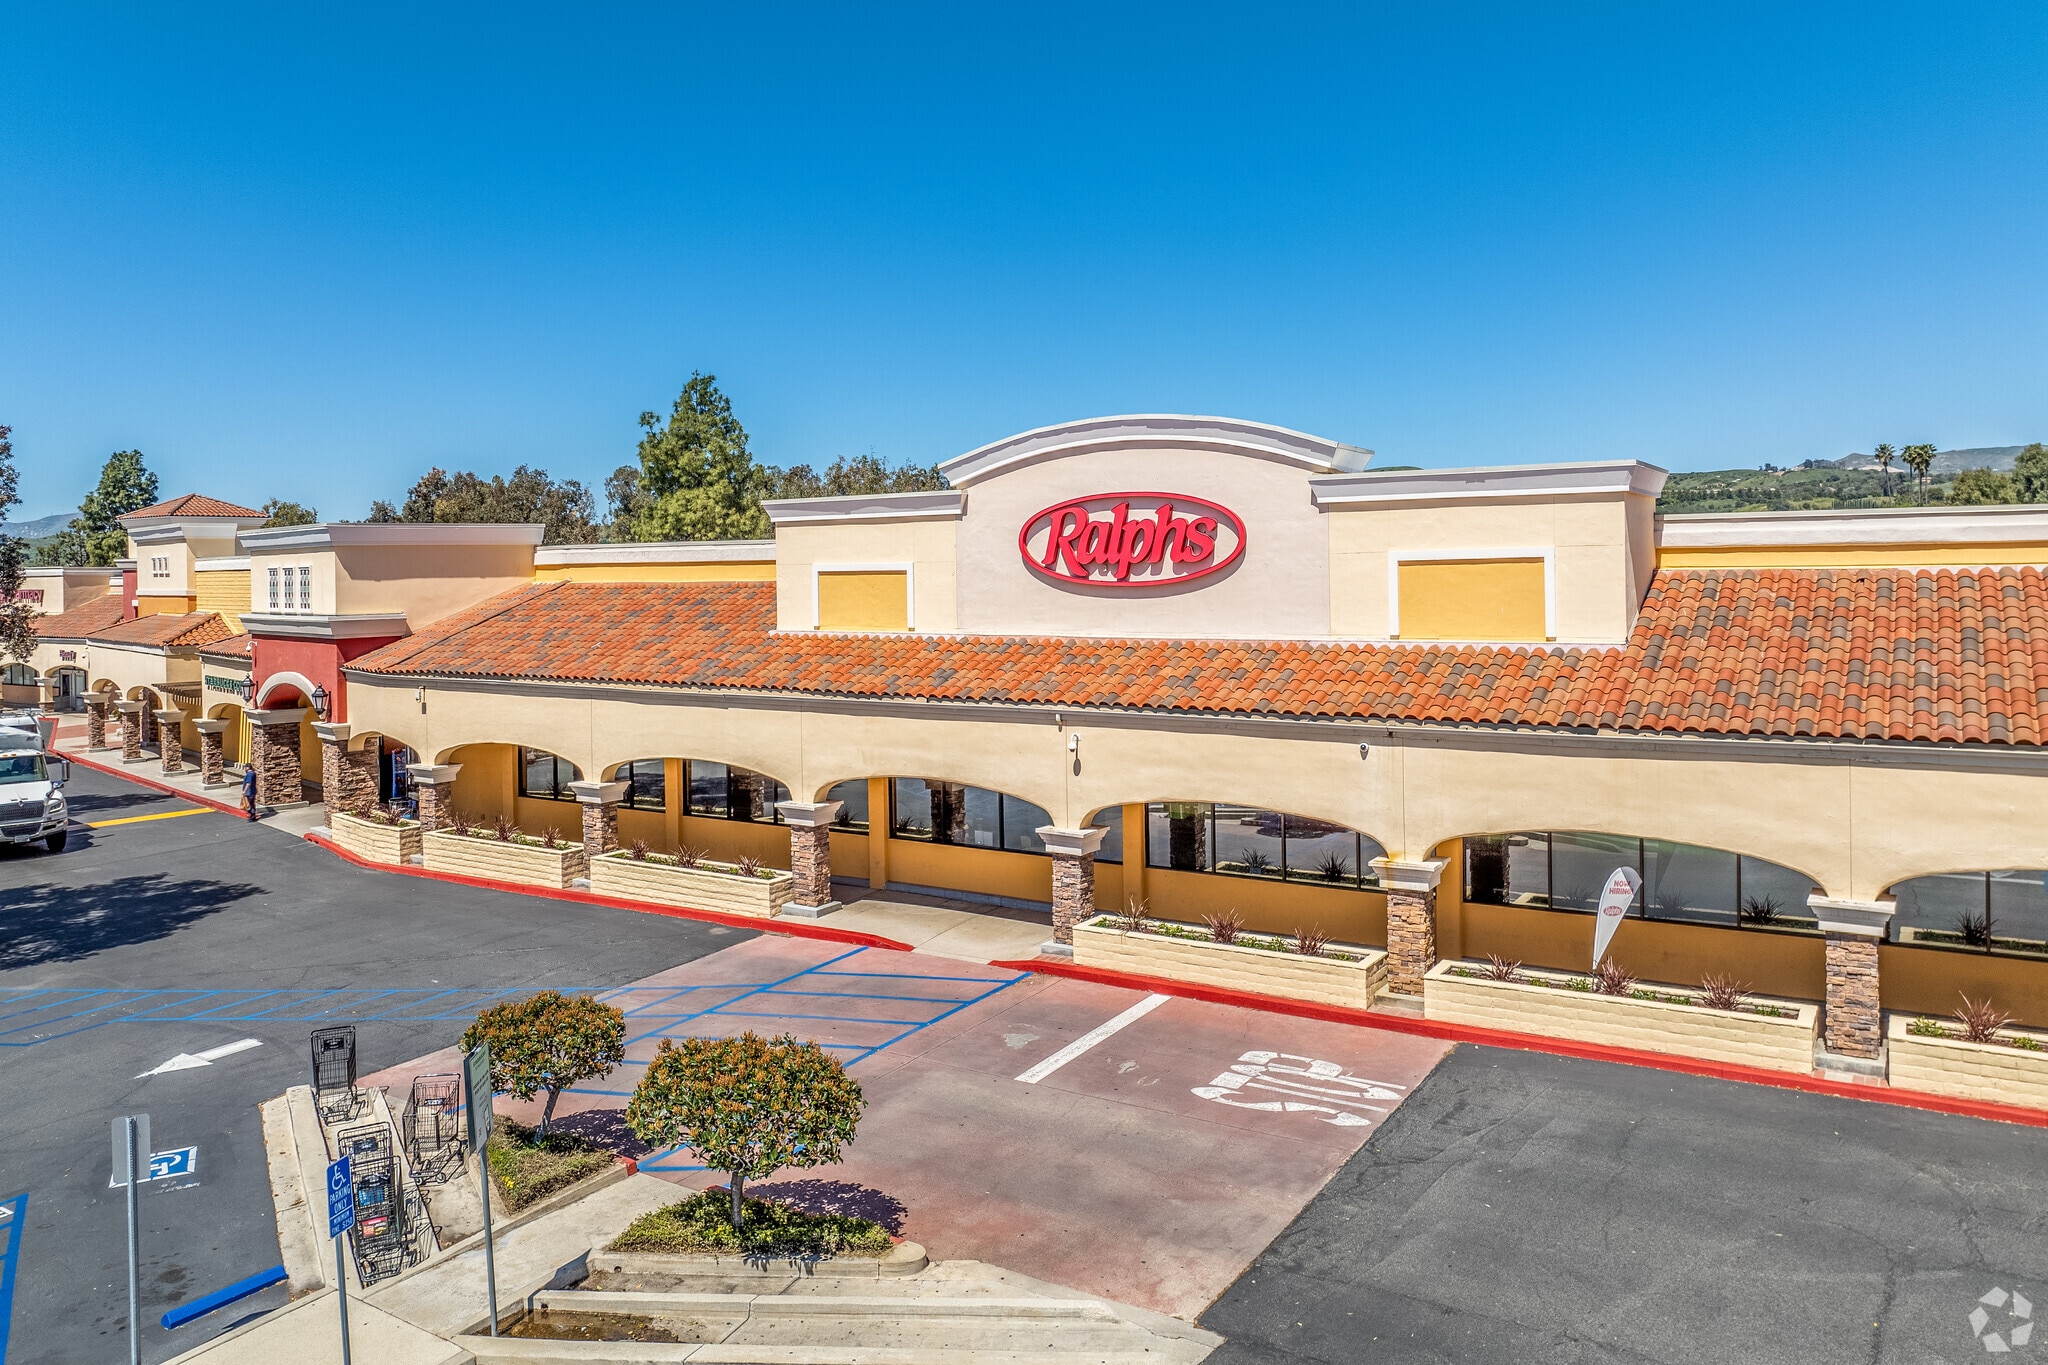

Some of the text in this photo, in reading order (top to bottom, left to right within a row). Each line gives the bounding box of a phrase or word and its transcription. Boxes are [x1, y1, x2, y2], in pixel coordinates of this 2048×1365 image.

[1041, 501, 1218, 579] Ralphs
[1190, 1050, 1408, 1127] STOP
[329, 1183, 351, 1206] PARKING
[334, 1197, 348, 1214] ONLY
[331, 1224, 340, 1236] FINE
[342, 1216, 353, 1229] $250
[333, 1210, 350, 1225] MINIMUM
